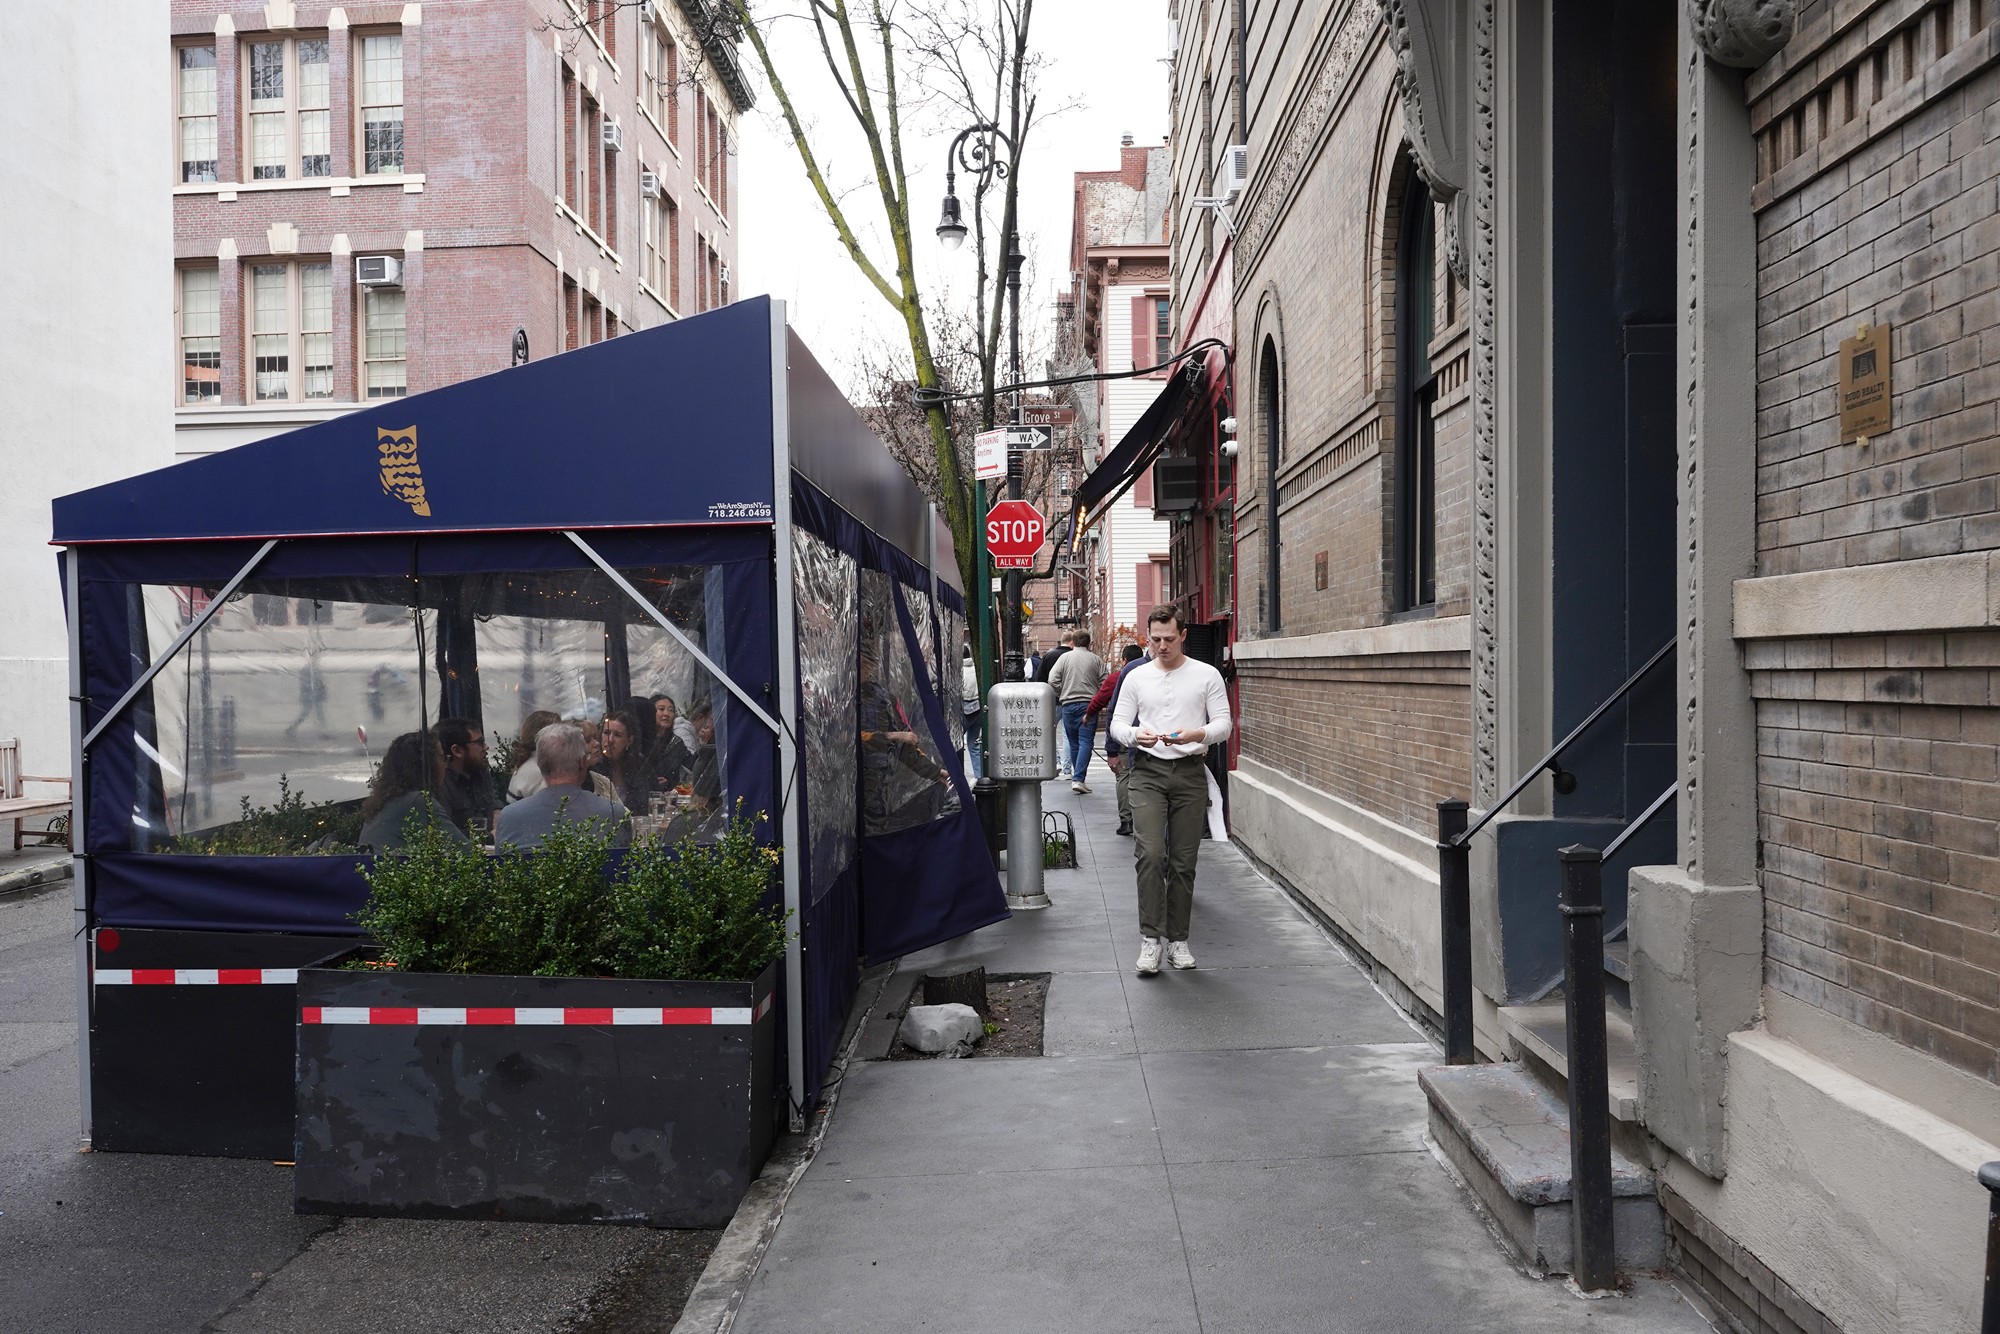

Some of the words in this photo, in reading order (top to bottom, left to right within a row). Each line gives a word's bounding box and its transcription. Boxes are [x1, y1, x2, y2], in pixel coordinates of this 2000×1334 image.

[1844, 389, 1861, 403] RUDD
[1861, 381, 1886, 397] REALTY
[1025, 411, 1051, 424] Grove
[1053, 411, 1061, 419] St
[1019, 433, 1041, 443] WAY
[708, 509, 771, 518] 718.246.0499
[987, 520, 1041, 543] STOP
[999, 558, 1012, 566] ALL
[1015, 558, 1029, 566] WAY
[1000, 727, 1042, 737] DRINKING
[1004, 739, 1038, 749] WATER
[999, 754, 1043, 765] SAMPLING
[1003, 767, 1040, 777] STATION
